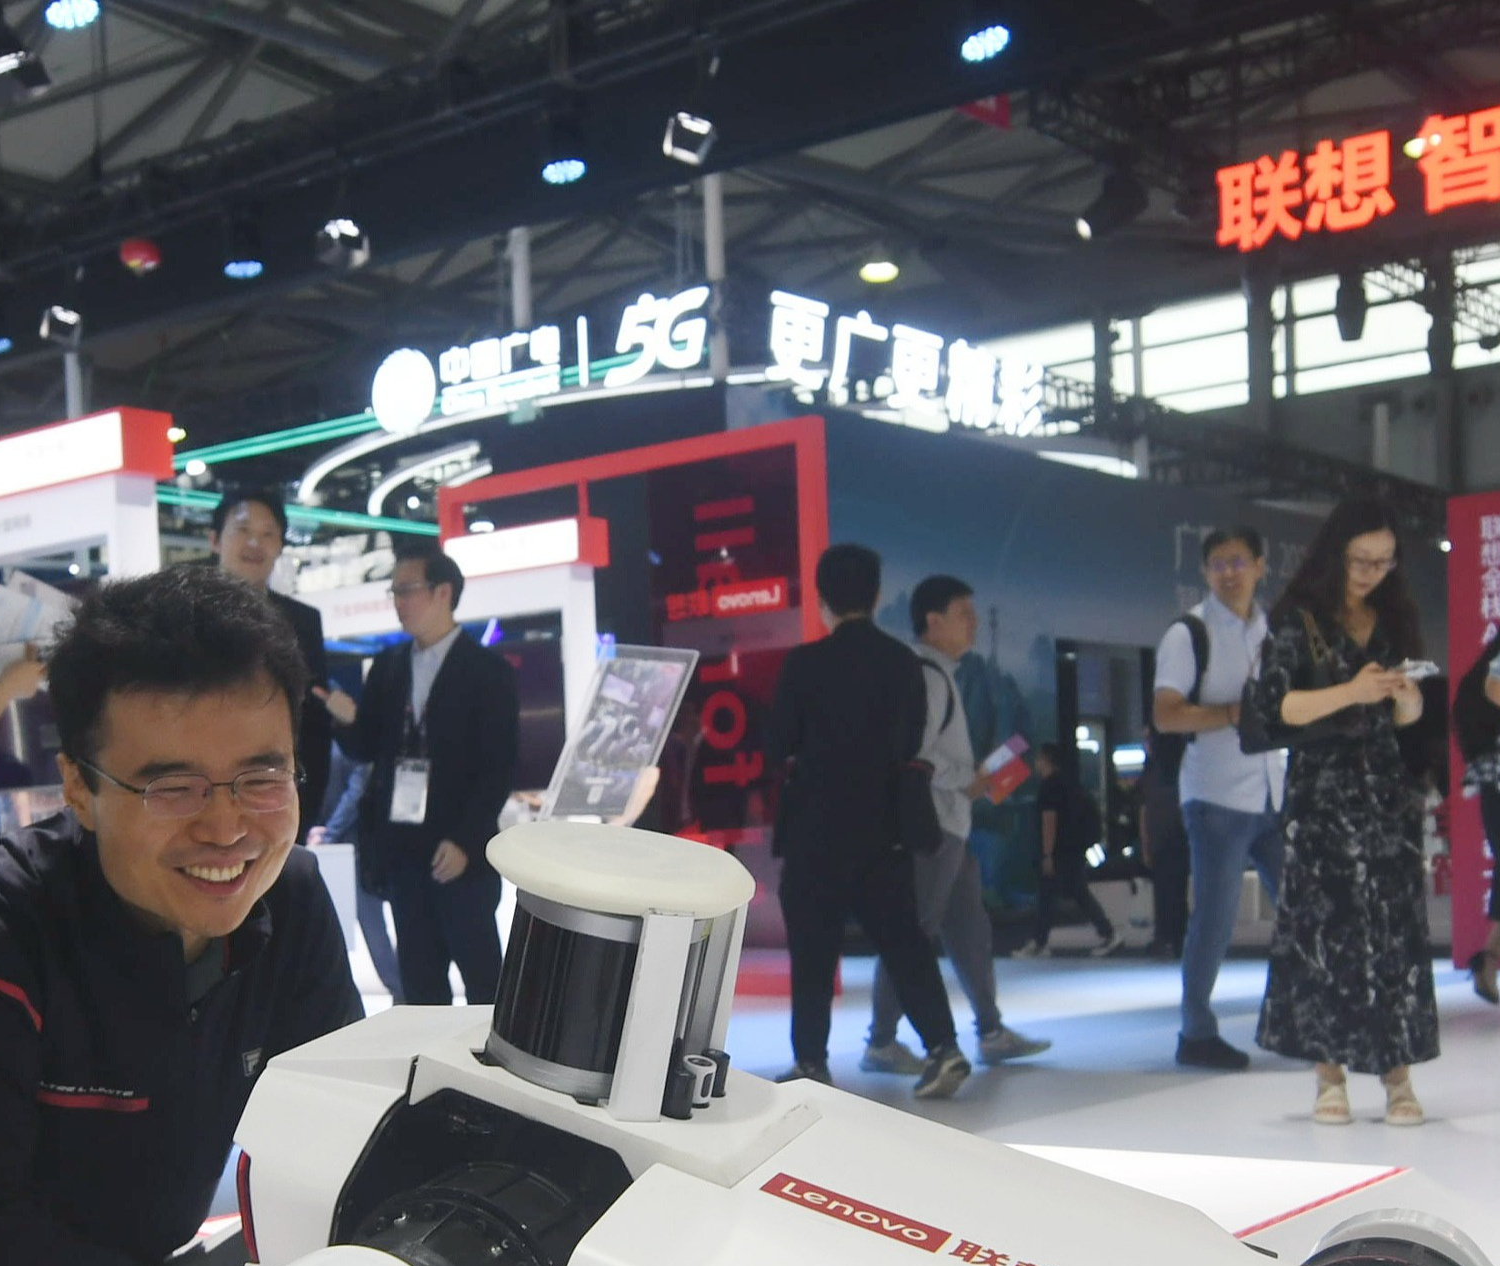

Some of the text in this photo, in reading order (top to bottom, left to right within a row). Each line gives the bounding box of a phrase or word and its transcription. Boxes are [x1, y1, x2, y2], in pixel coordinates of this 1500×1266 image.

[1215, 129, 1395, 253] 联想
[604, 286, 710, 388] 5G
[765, 289, 1045, 438] 更广更精彩
[780, 1181, 930, 1243] Lenovo
